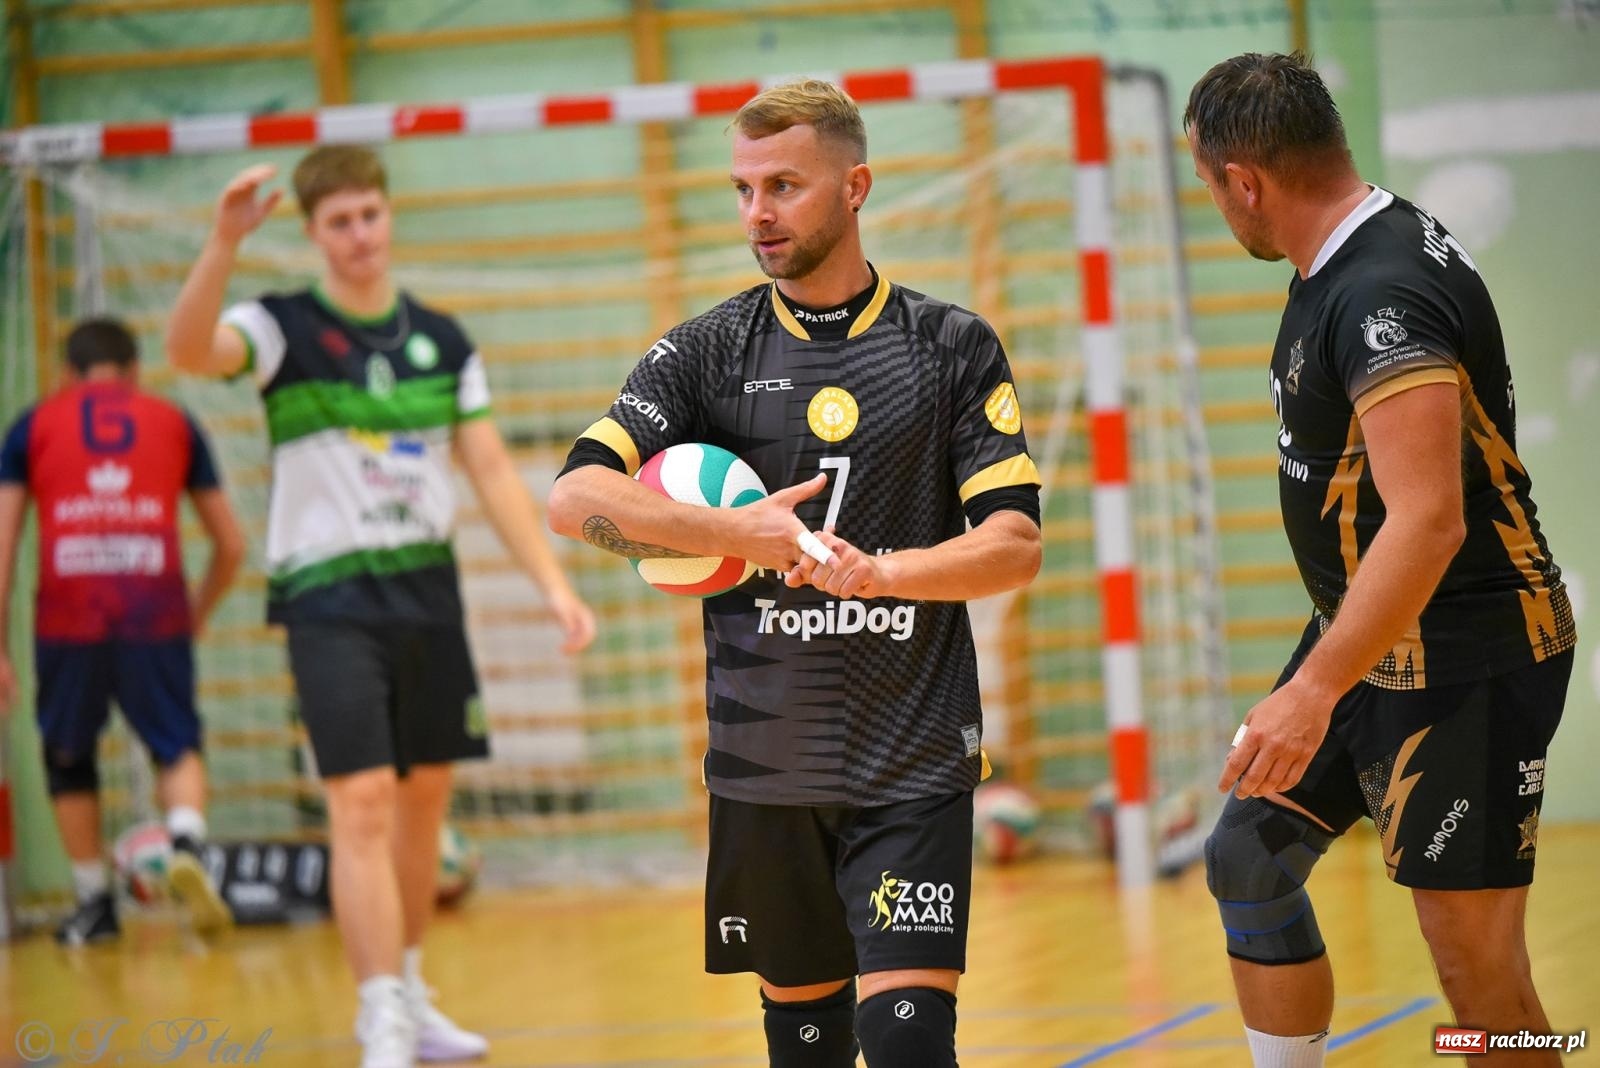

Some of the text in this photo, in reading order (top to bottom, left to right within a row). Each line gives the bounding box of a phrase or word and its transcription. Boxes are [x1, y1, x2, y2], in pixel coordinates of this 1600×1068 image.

[805, 308, 849, 322] PATRICK
[1377, 307, 1406, 320] FALI
[1393, 350, 1427, 362] Mrowiec
[819, 456, 850, 532] 7
[755, 598, 915, 641] TropiDog
[1525, 771, 1543, 783] SIDE
[897, 882, 954, 904] ZOO
[892, 903, 954, 924] MAR
[892, 924, 954, 934] sklep zoologiczny
